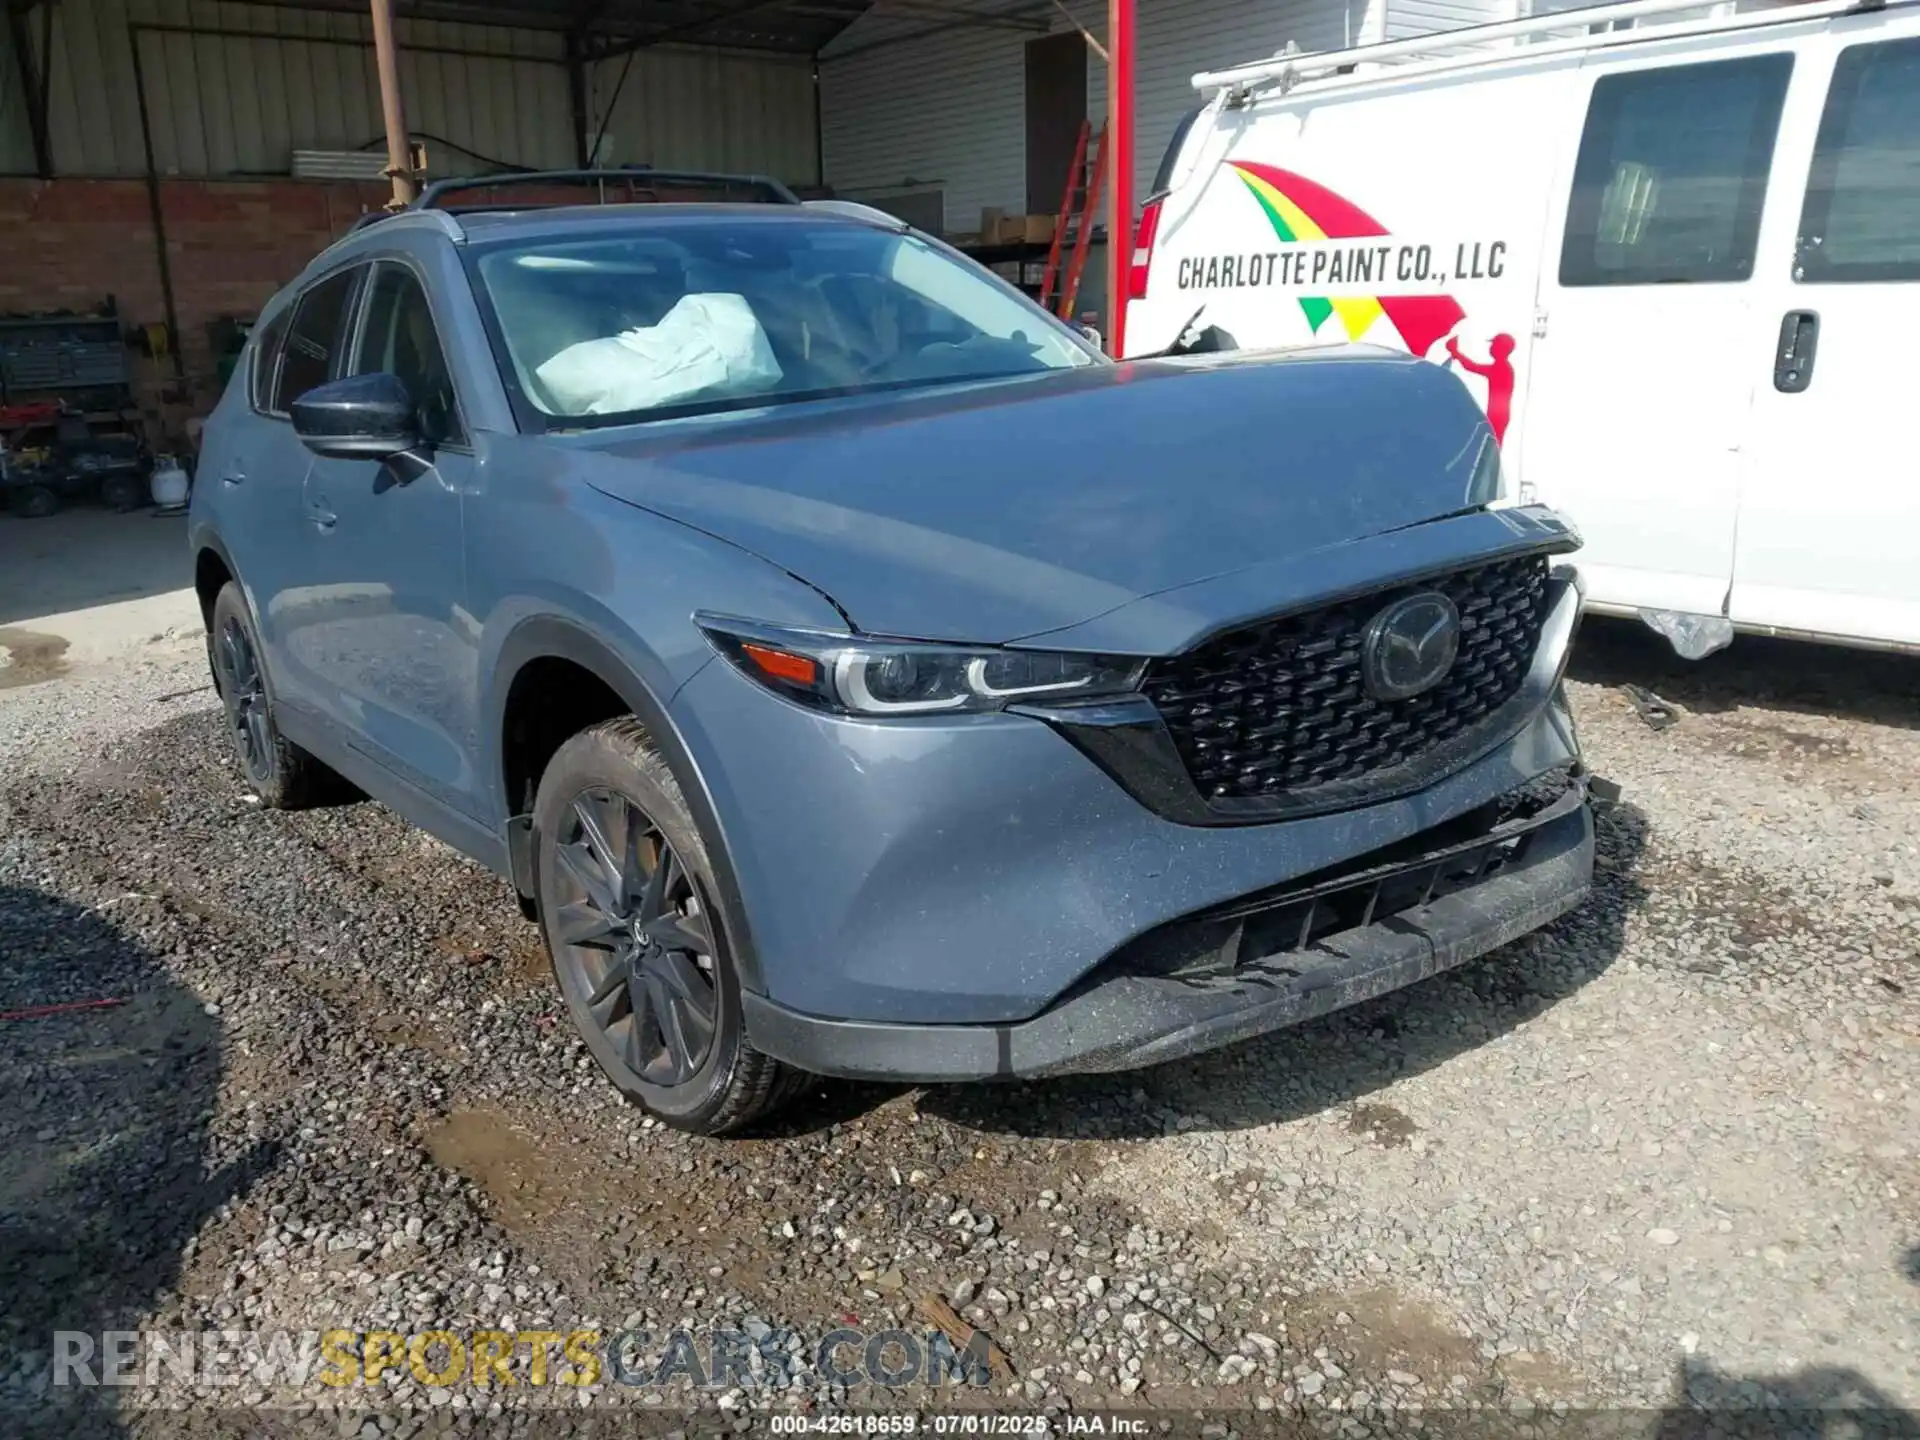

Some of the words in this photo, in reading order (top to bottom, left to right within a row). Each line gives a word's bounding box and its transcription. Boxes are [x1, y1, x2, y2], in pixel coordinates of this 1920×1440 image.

[1178, 251, 1306, 289] CHARLOTTE
[1311, 247, 1392, 283] PAINT
[1396, 244, 1447, 287] CO.,
[1454, 240, 1507, 279] LLC
